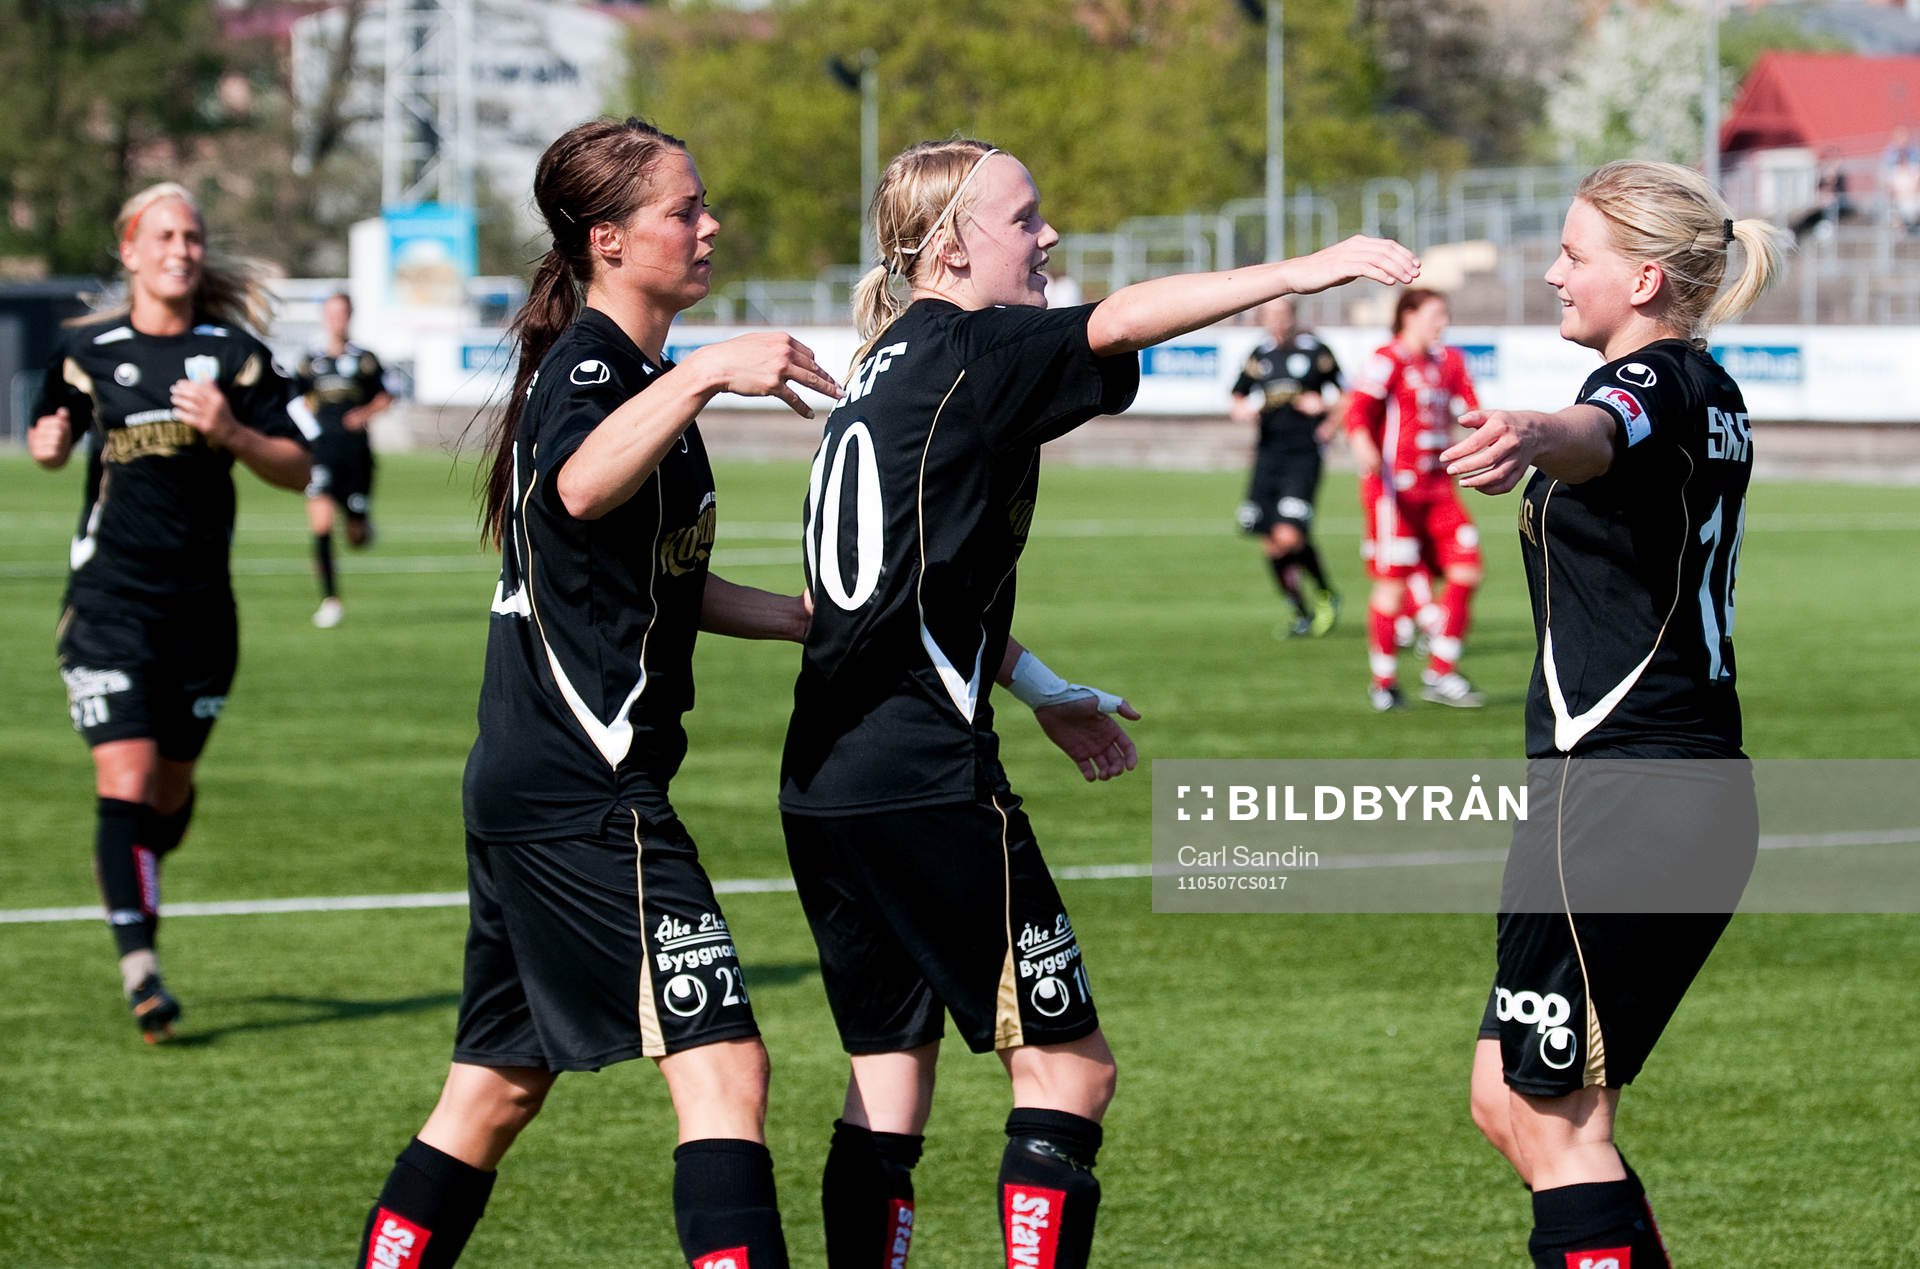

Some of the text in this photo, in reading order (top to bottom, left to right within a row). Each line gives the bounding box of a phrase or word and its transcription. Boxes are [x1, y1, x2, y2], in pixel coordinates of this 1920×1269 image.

[828, 341, 908, 418] KF
[1707, 406, 1752, 463] SKF
[806, 421, 884, 611] 10
[654, 914, 691, 943] Åke
[1017, 922, 1050, 951] Åke
[715, 966, 749, 1007] 23
[1495, 986, 1571, 1035] oop
